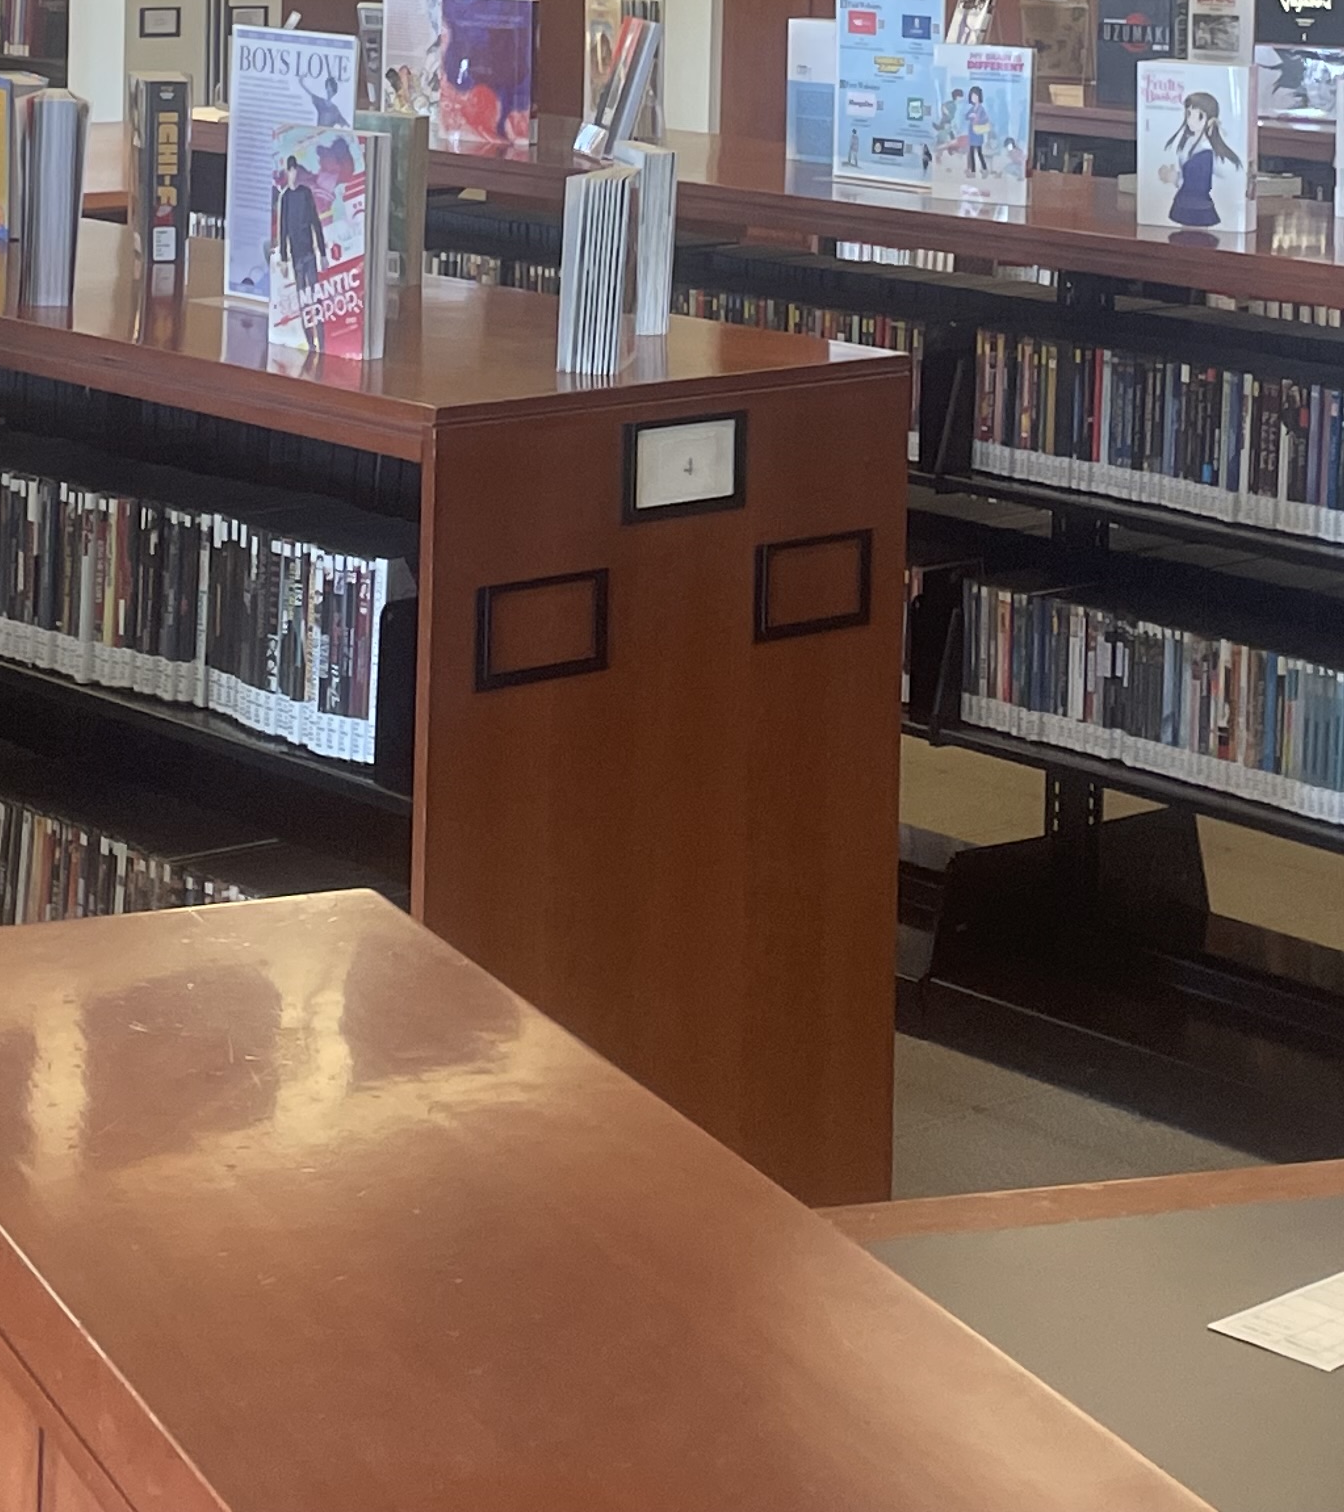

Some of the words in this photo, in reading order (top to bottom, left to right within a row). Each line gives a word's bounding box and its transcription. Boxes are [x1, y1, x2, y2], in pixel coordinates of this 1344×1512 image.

[1103, 23, 1171, 44] UZUMAKI
[239, 45, 291, 76] BOYS
[295, 50, 352, 83] LOVE
